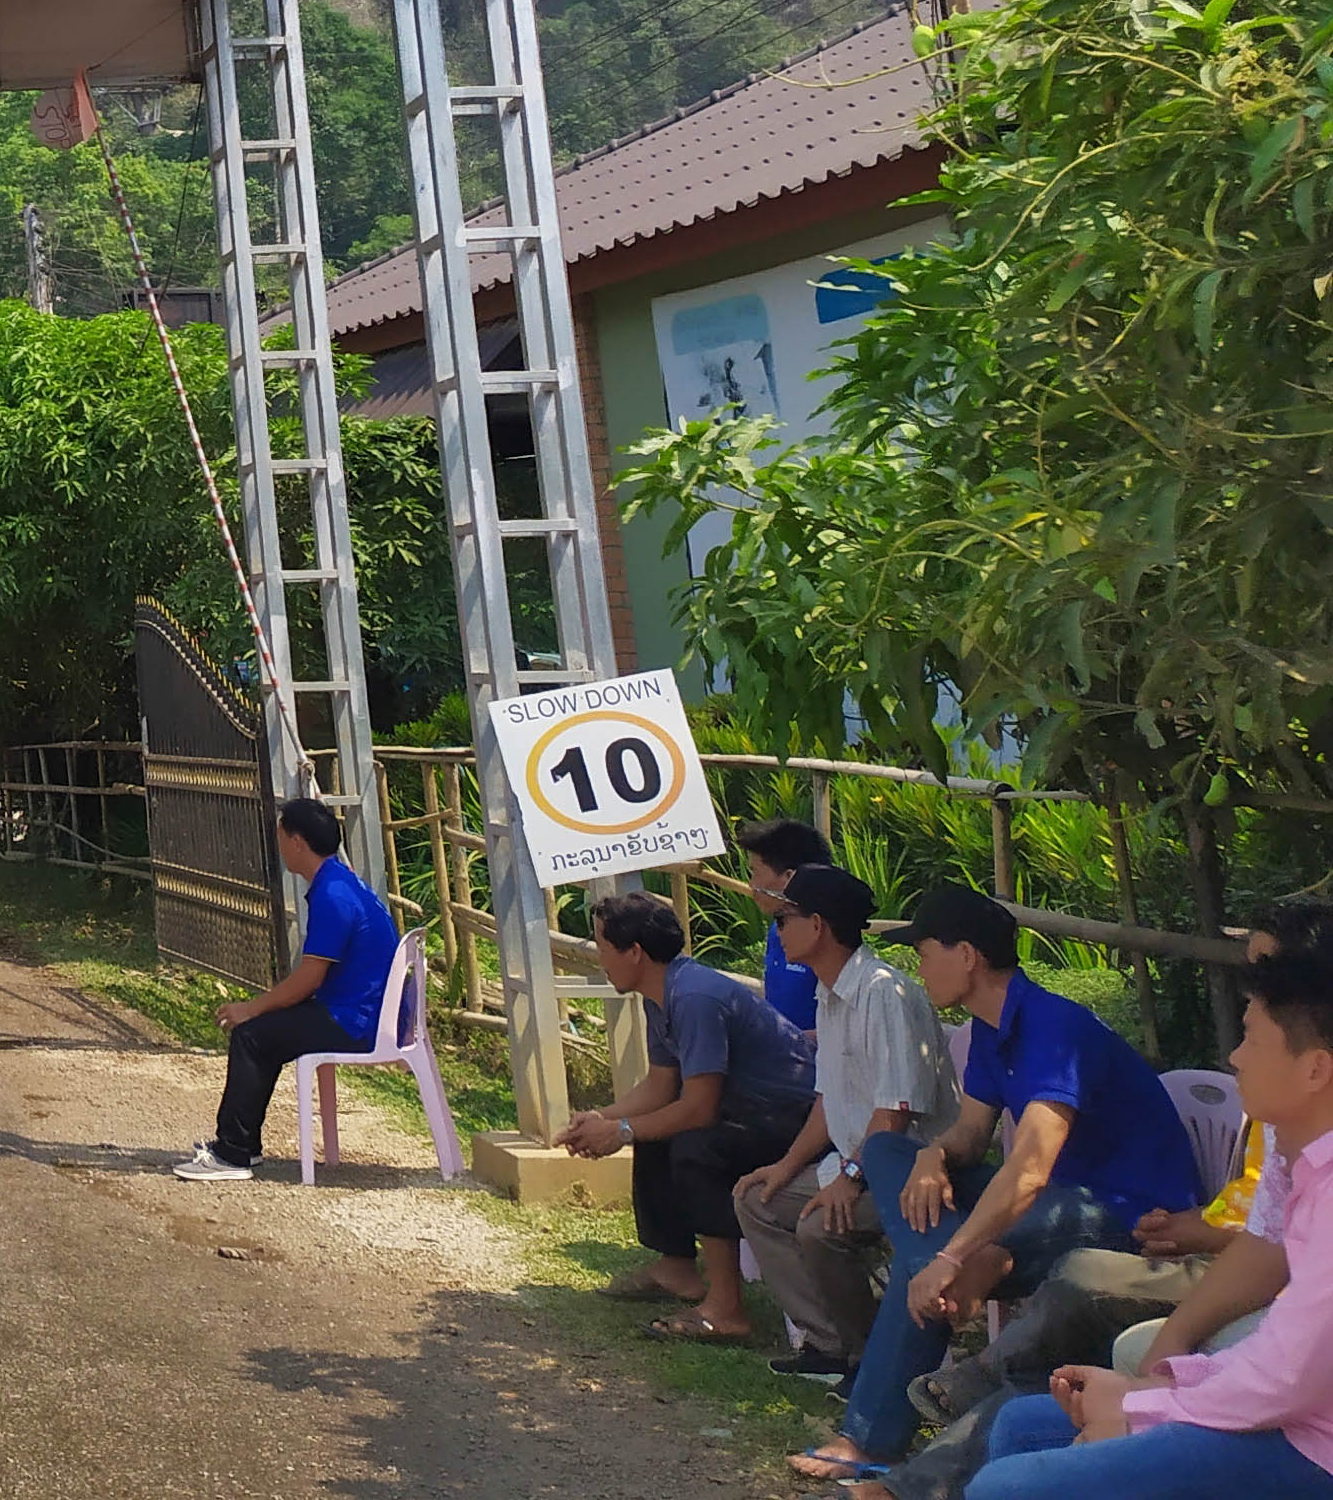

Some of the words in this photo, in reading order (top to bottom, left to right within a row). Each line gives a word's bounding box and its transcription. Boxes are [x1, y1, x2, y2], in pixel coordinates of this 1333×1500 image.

[508, 693, 578, 723] SLOW
[585, 677, 662, 709] DOWN
[550, 737, 662, 813] 10
